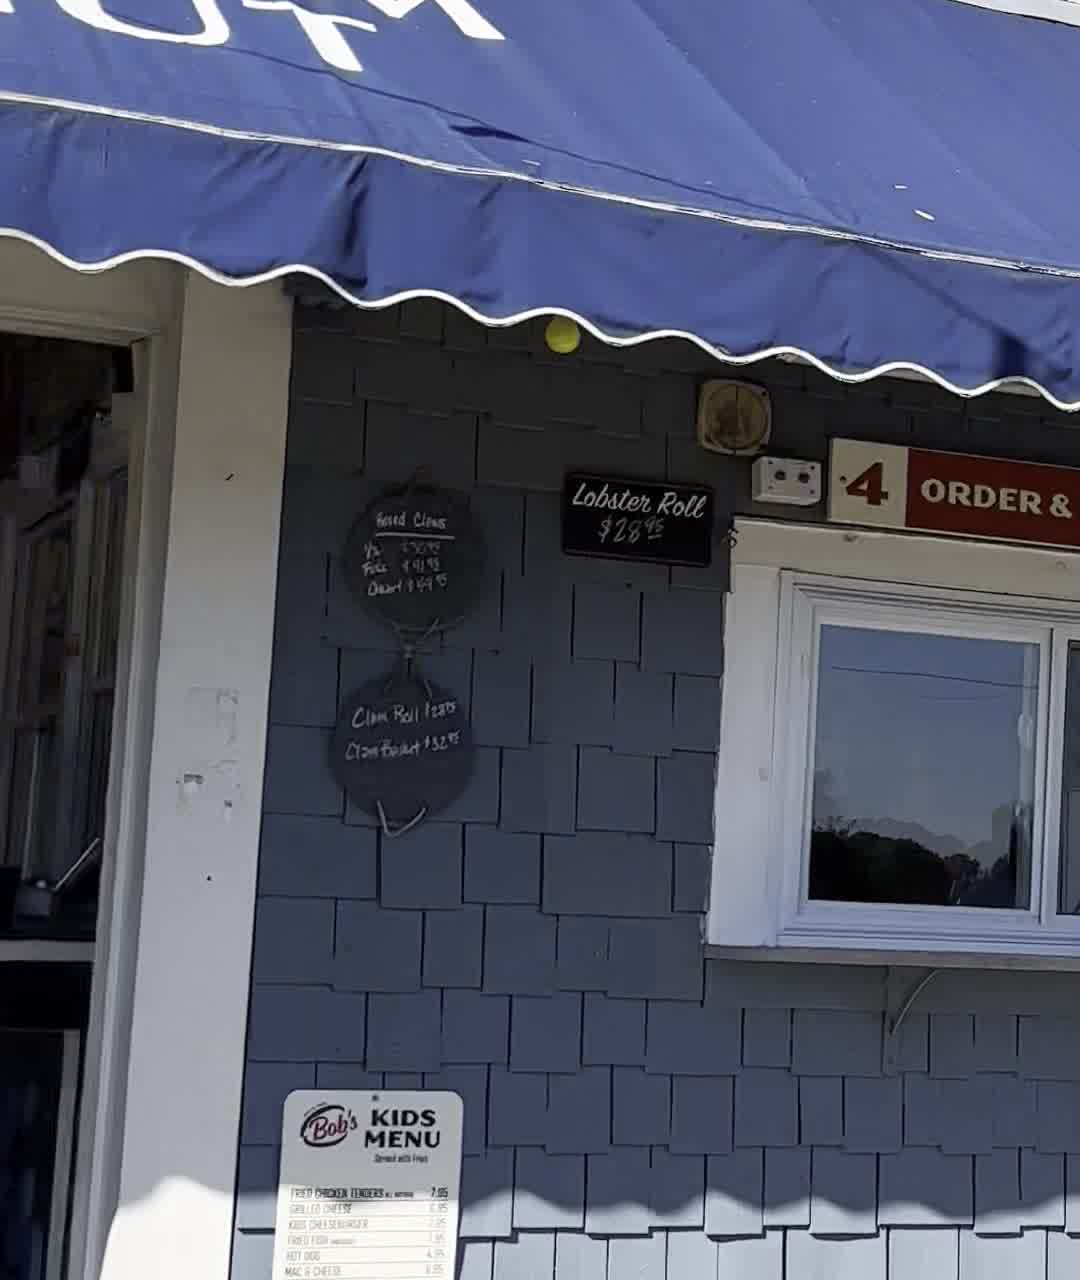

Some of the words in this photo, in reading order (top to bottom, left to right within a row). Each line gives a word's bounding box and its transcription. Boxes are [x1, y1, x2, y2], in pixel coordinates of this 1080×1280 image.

[572, 482, 651, 512] Lobster
[657, 492, 707, 518] Roll
[845, 461, 889, 506] 4
[921, 478, 1042, 515] ORDER
[1049, 494, 1072, 518] &
[309, 1109, 358, 1141] Bob's
[372, 1109, 436, 1127] KIDS
[365, 1131, 440, 1148] MENU
